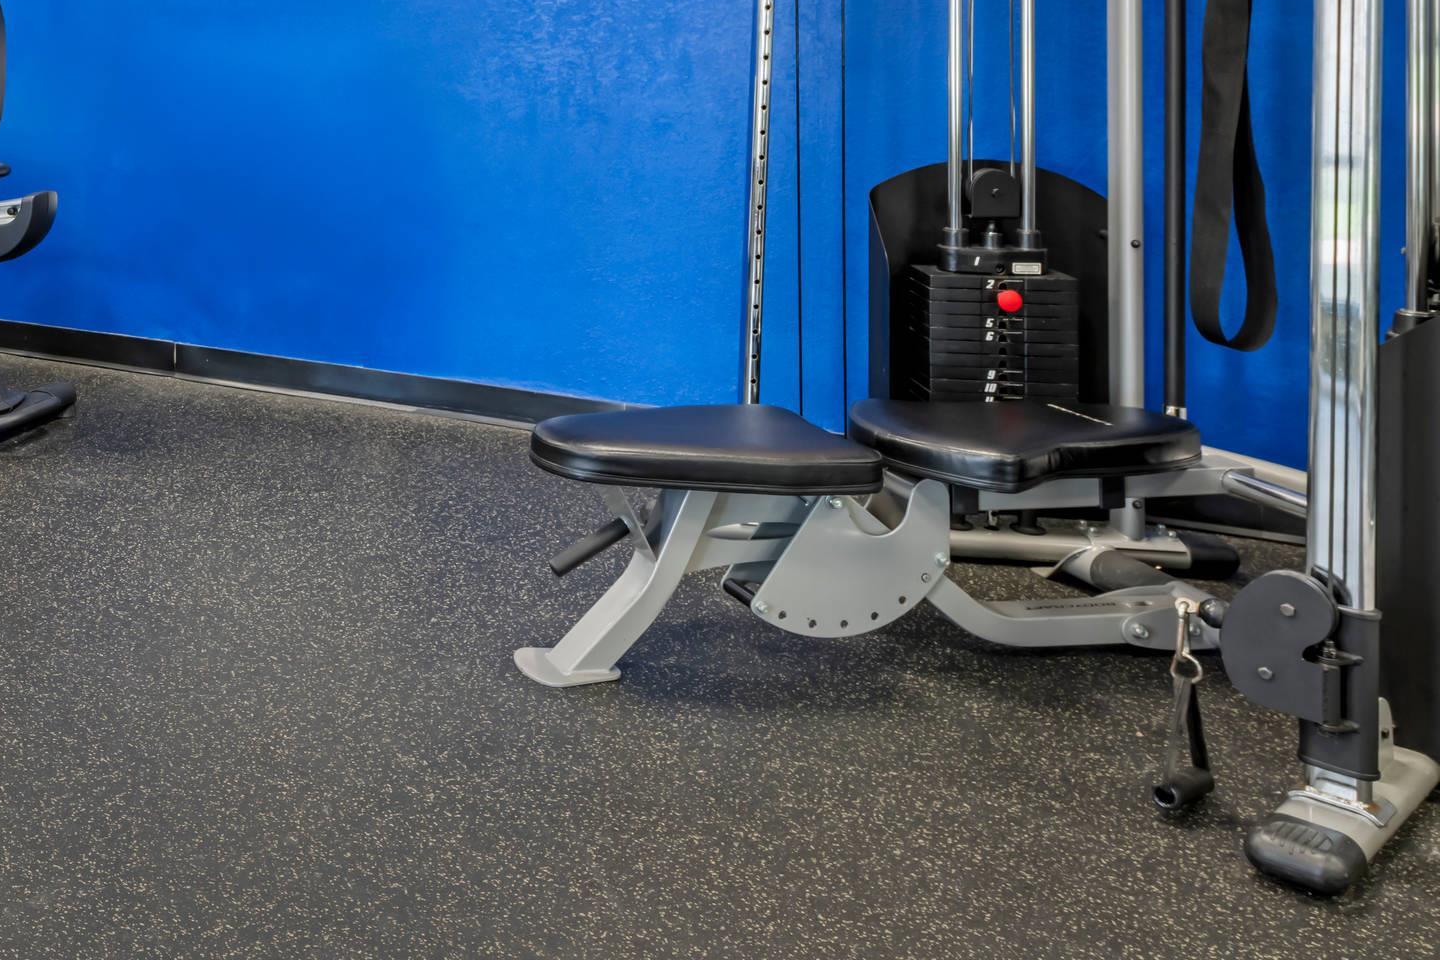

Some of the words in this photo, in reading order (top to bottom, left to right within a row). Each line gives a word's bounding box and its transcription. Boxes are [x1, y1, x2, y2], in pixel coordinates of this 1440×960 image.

[986, 279, 995, 289] 2
[985, 318, 994, 328] 5
[985, 331, 994, 341] 6
[987, 370, 996, 380] 9
[984, 383, 997, 393] 10
